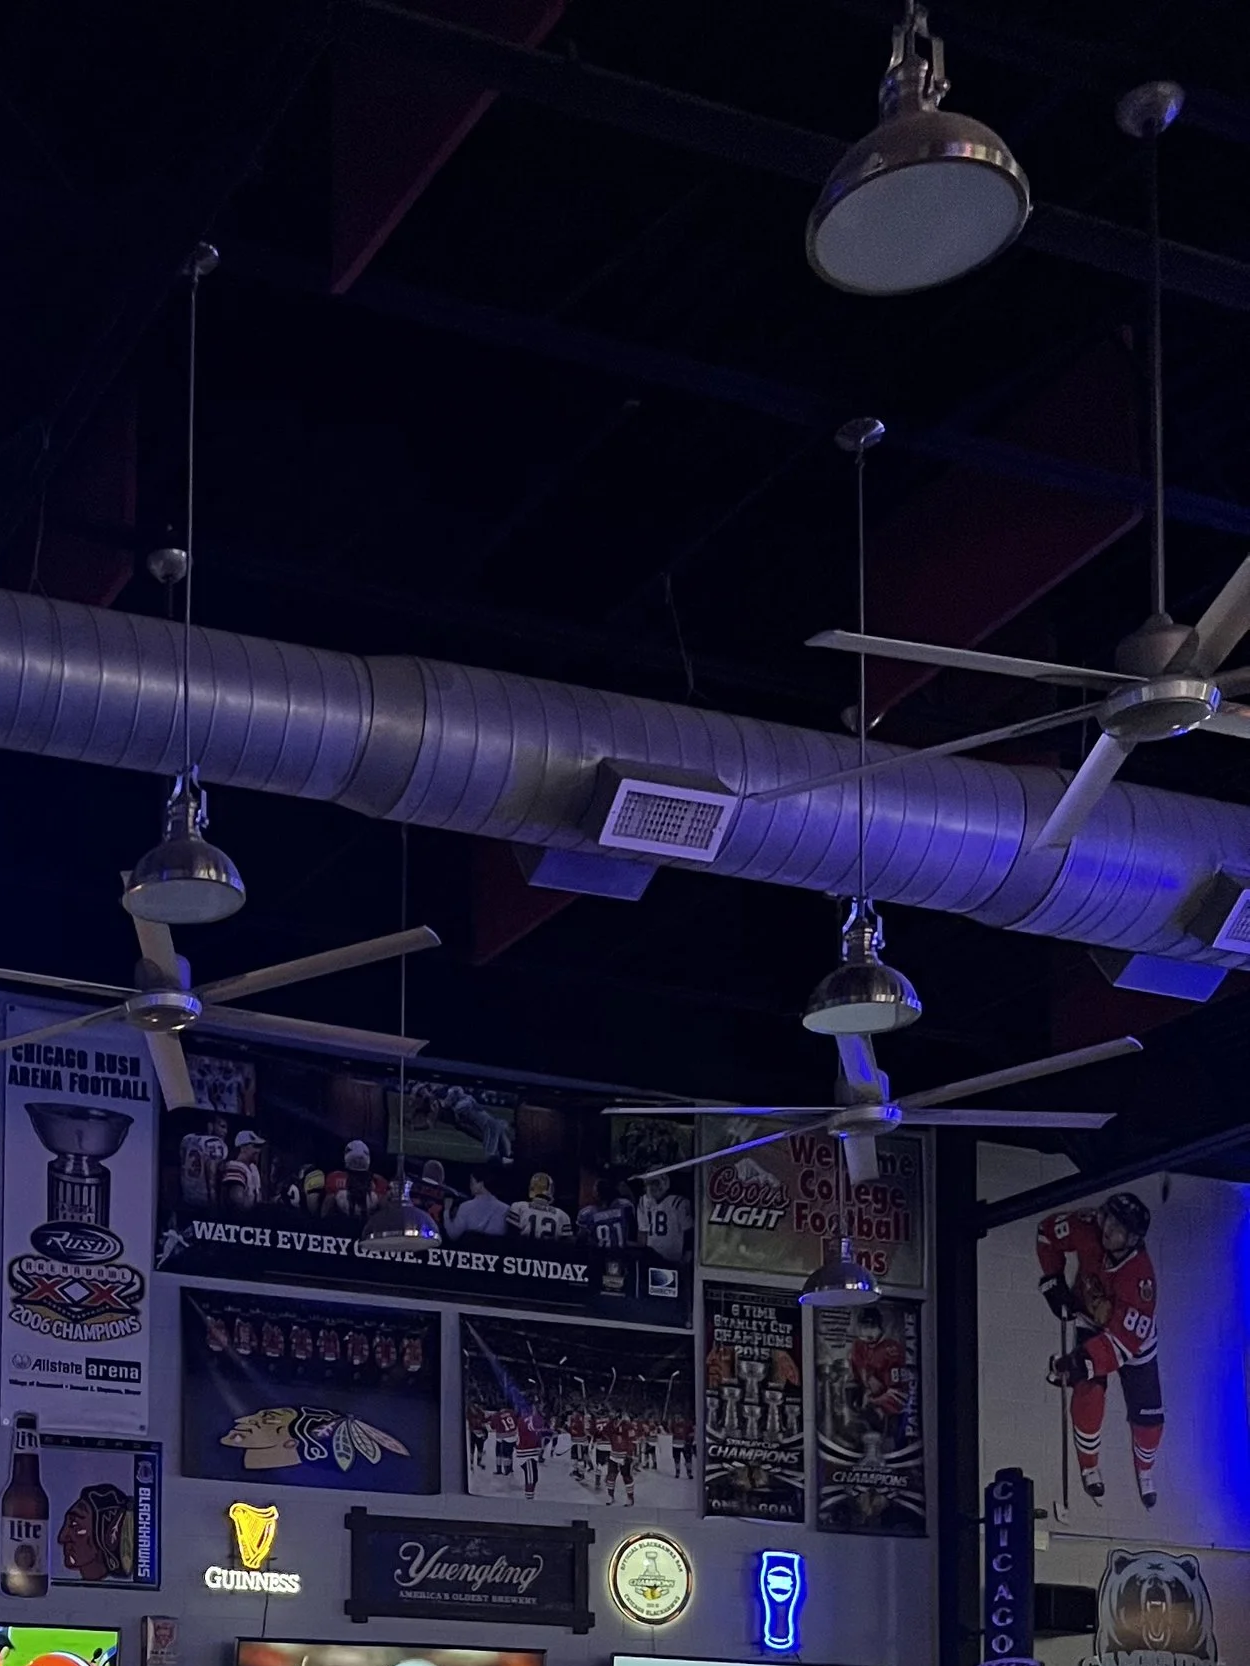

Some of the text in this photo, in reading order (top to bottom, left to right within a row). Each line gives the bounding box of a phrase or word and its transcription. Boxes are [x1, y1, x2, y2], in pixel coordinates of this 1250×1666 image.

[11, 1043, 141, 1077] CHICAGO RUSH
[8, 1064, 151, 1102] ARENA FOOTBALL
[789, 1134, 916, 1176] Welme
[709, 1166, 790, 1208] Coors
[708, 1204, 785, 1230] LIGHT
[193, 1220, 271, 1247] WATCH
[276, 1230, 351, 1256] EVERY
[427, 1248, 499, 1273] EVERY
[503, 1256, 589, 1282] SUNDAY.
[10, 1304, 141, 1341] 2006 CHAMPIONS
[743, 1305, 776, 1320] TIME
[1123, 1306, 1151, 1340] 88
[714, 1328, 793, 1349] CHAMPIONS
[734, 1344, 771, 1361] 2015
[31, 1358, 139, 1380] Allstate arena
[707, 1444, 800, 1464] CHAMPIONS
[832, 1470, 911, 1488] CHAMPIONS
[758, 1502, 795, 1515] GOAL
[9, 1519, 42, 1541] Lite
[137, 1486, 151, 1578] BLACKHAWKS
[204, 1566, 301, 1593] GUINNESS
[394, 1541, 544, 1594] Yuengling
[991, 1480, 1015, 1654] CHICAGO
[399, 1589, 538, 1605] AMERICA'S OLDEST BREWERY
